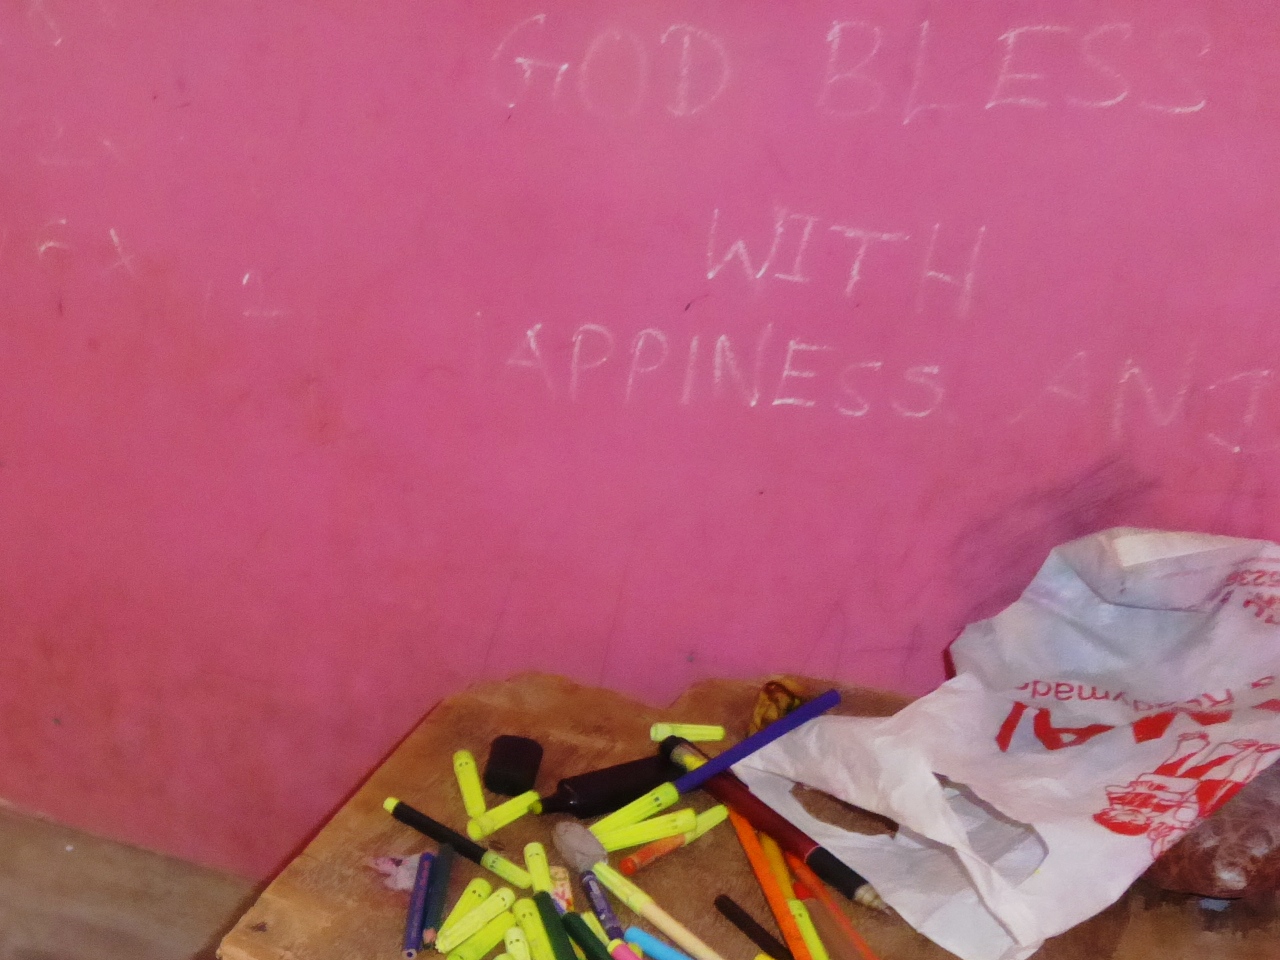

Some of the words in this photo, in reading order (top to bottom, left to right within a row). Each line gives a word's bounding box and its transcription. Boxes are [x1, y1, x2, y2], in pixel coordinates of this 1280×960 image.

[491, 14, 731, 117] GOD
[816, 20, 1211, 125] BLESS
[707, 208, 987, 317] WITH
